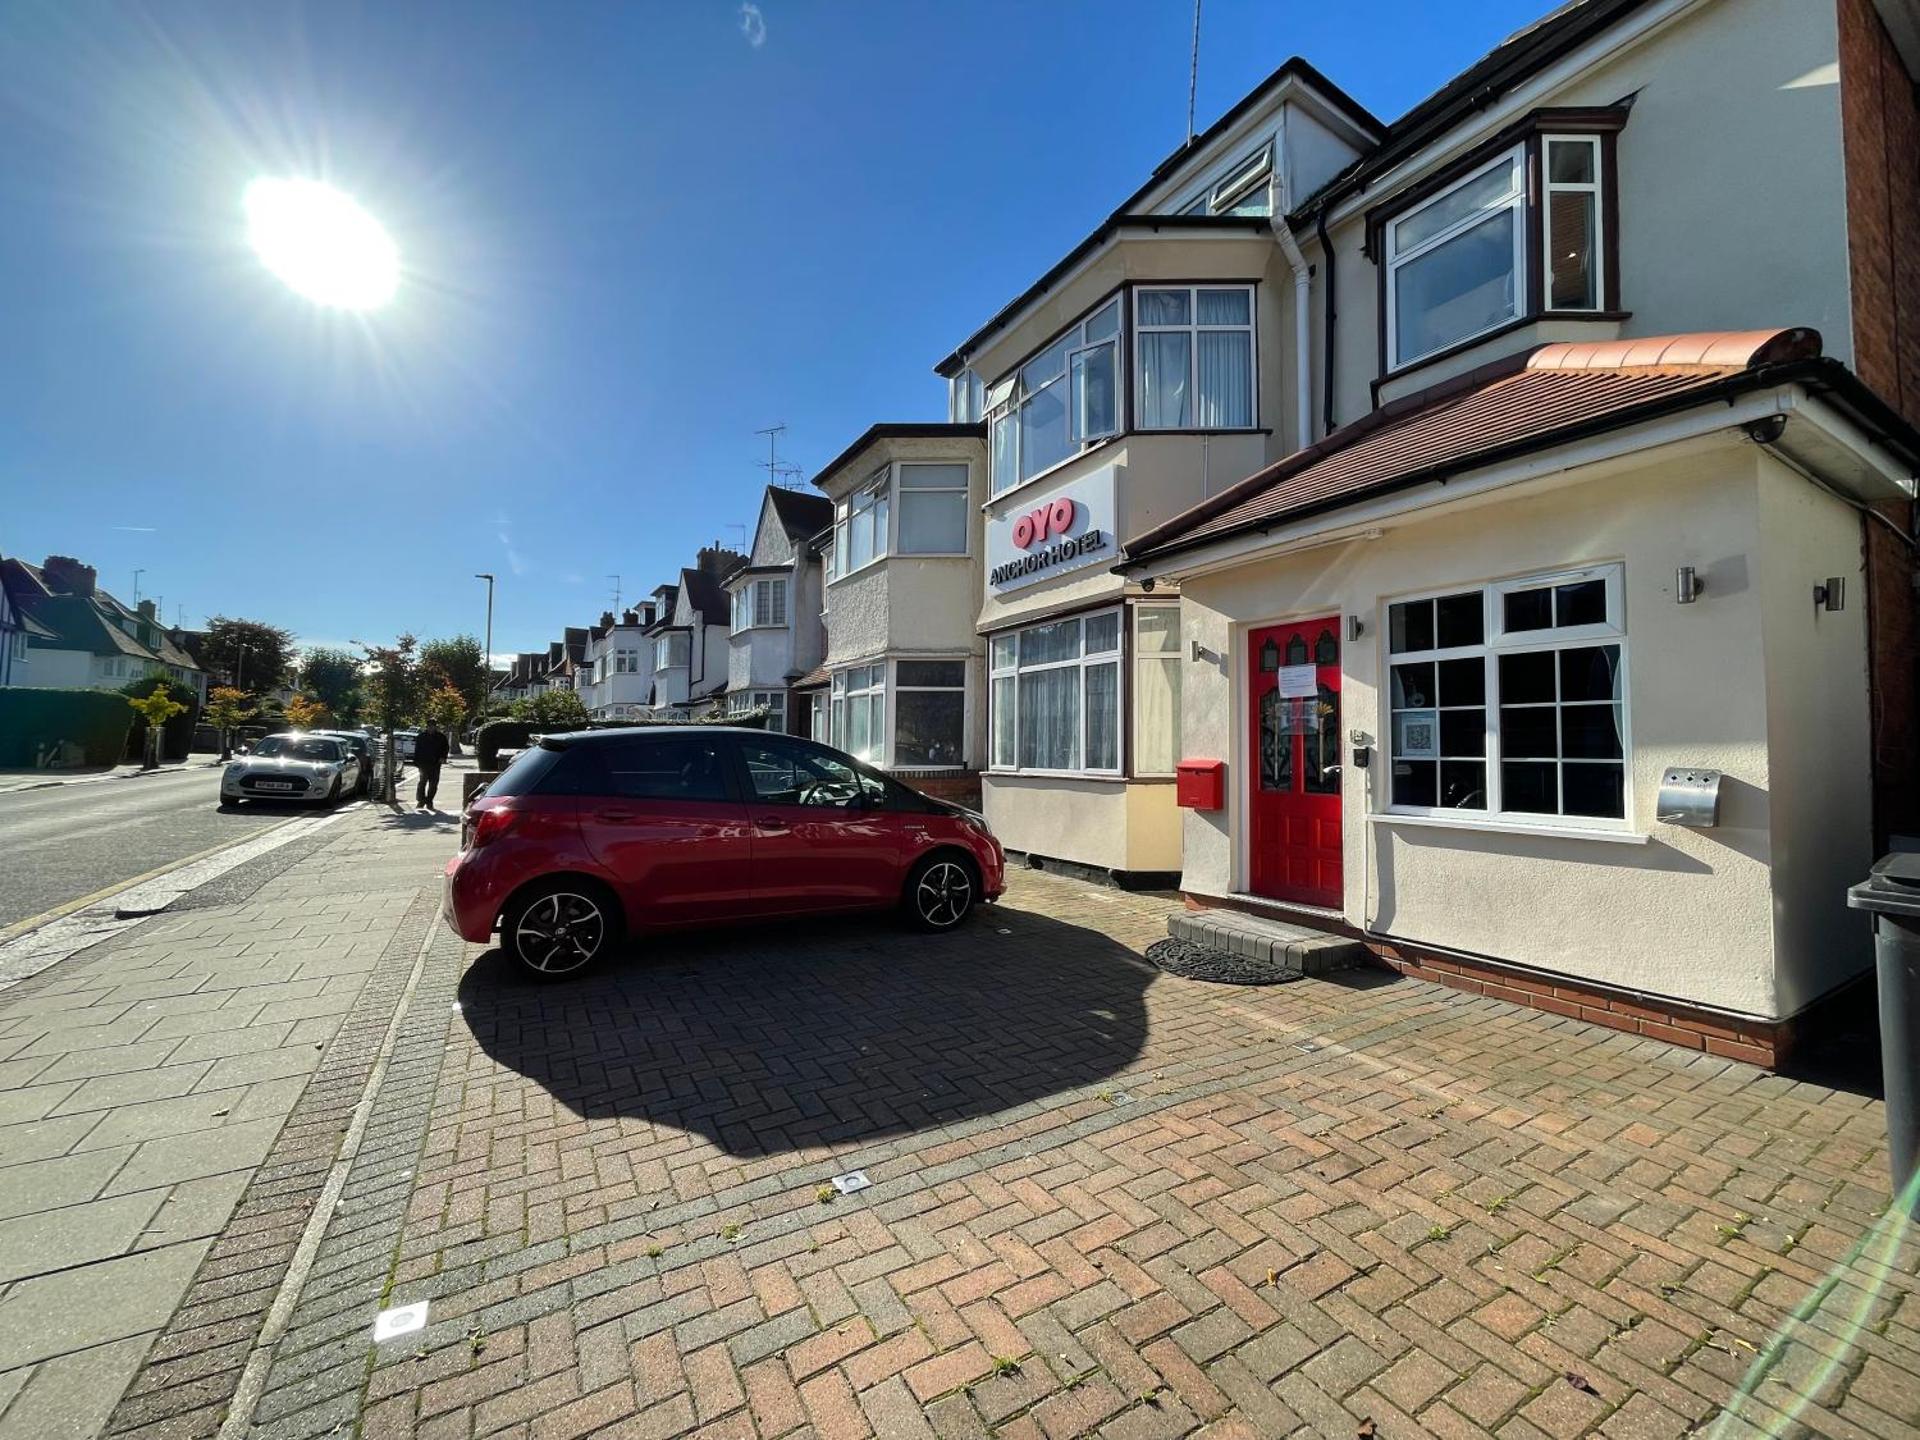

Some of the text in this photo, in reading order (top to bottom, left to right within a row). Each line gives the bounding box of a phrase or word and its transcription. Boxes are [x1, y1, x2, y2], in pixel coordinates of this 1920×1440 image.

[1012, 497, 1074, 549] OYO
[990, 530, 1107, 586] ANCHOR HOTEL
